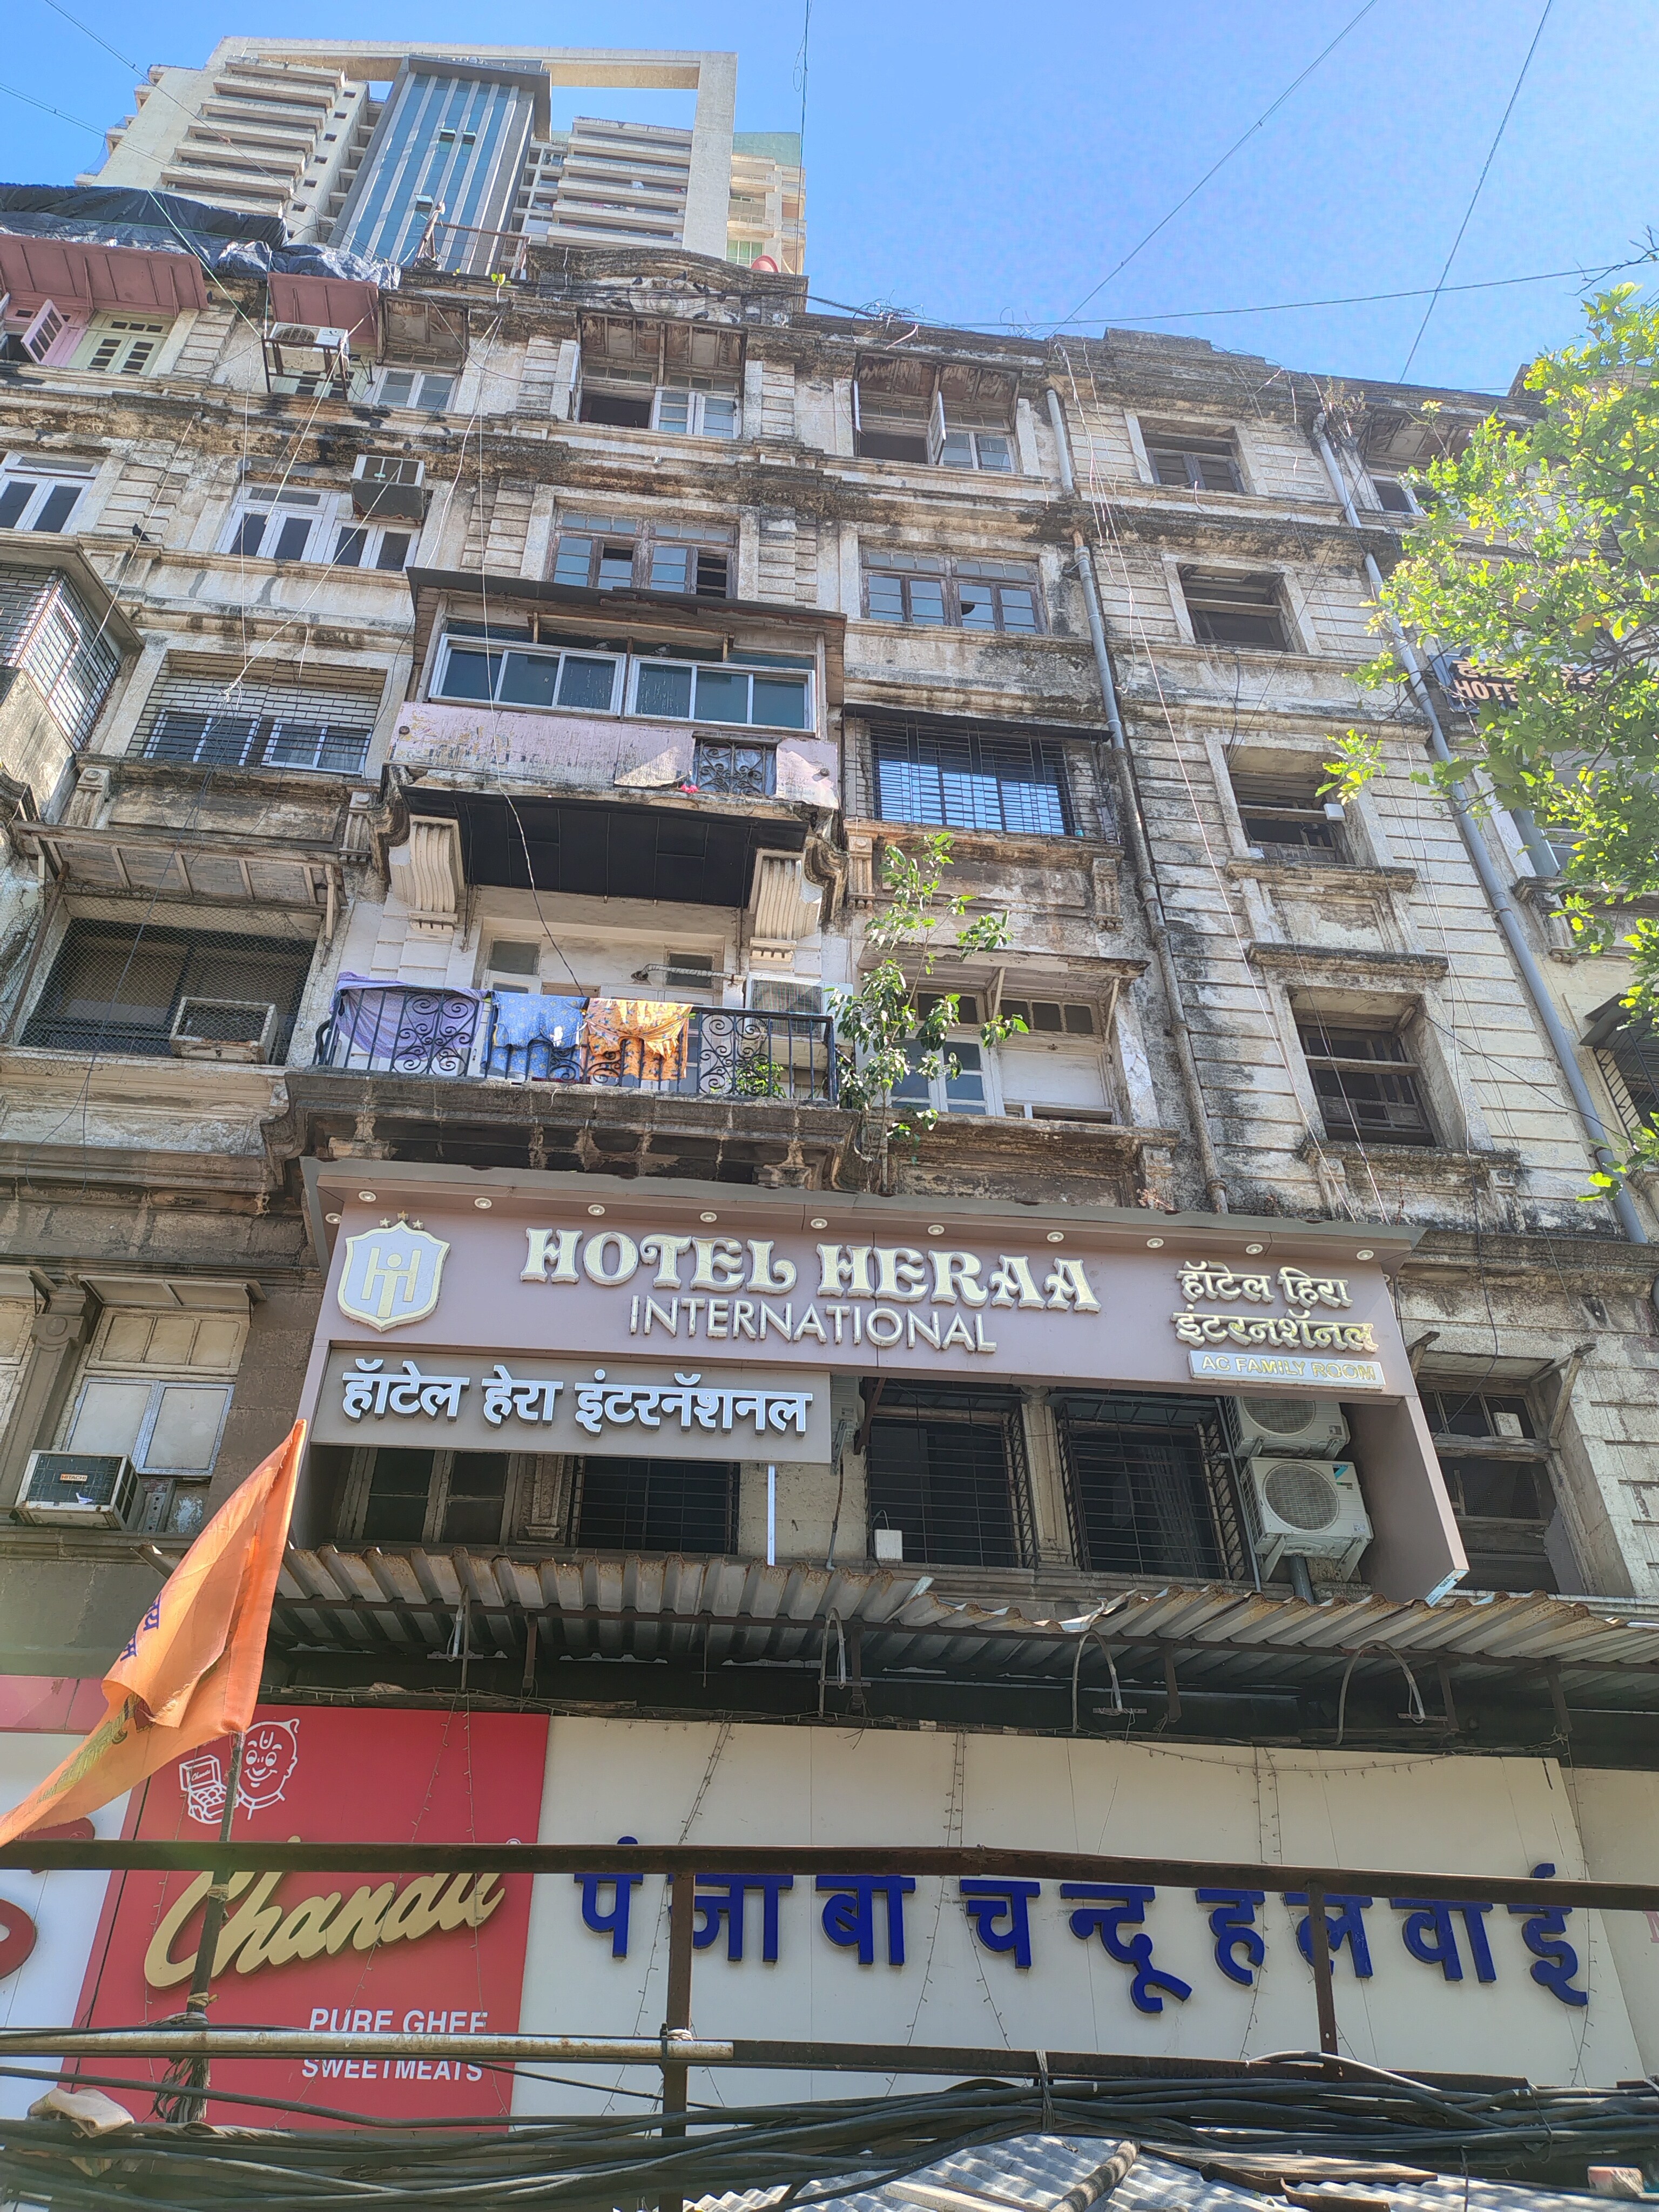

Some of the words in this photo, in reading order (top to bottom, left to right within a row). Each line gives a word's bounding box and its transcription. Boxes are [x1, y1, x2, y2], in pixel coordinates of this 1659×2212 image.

[1453, 679, 1533, 703] HOTE
[521, 1228, 797, 1294] HOTEL
[817, 1243, 1101, 1313] HERAA
[1176, 1260, 1275, 1302] हॉटेल
[1277, 1266, 1353, 1308] हिरा
[630, 1295, 997, 1352] INTERNATIONAL
[1202, 1355, 1231, 1371] AC
[1235, 1358, 1306, 1376] FAMILY
[1311, 1361, 1377, 1381] ROOM
[342, 1358, 470, 1422] हॉटेल
[482, 1365, 564, 1428] हेरा
[309, 2008, 394, 2032] PURE
[402, 2009, 488, 2033] GHEE
[302, 2059, 482, 2082] SWEETMEATS
